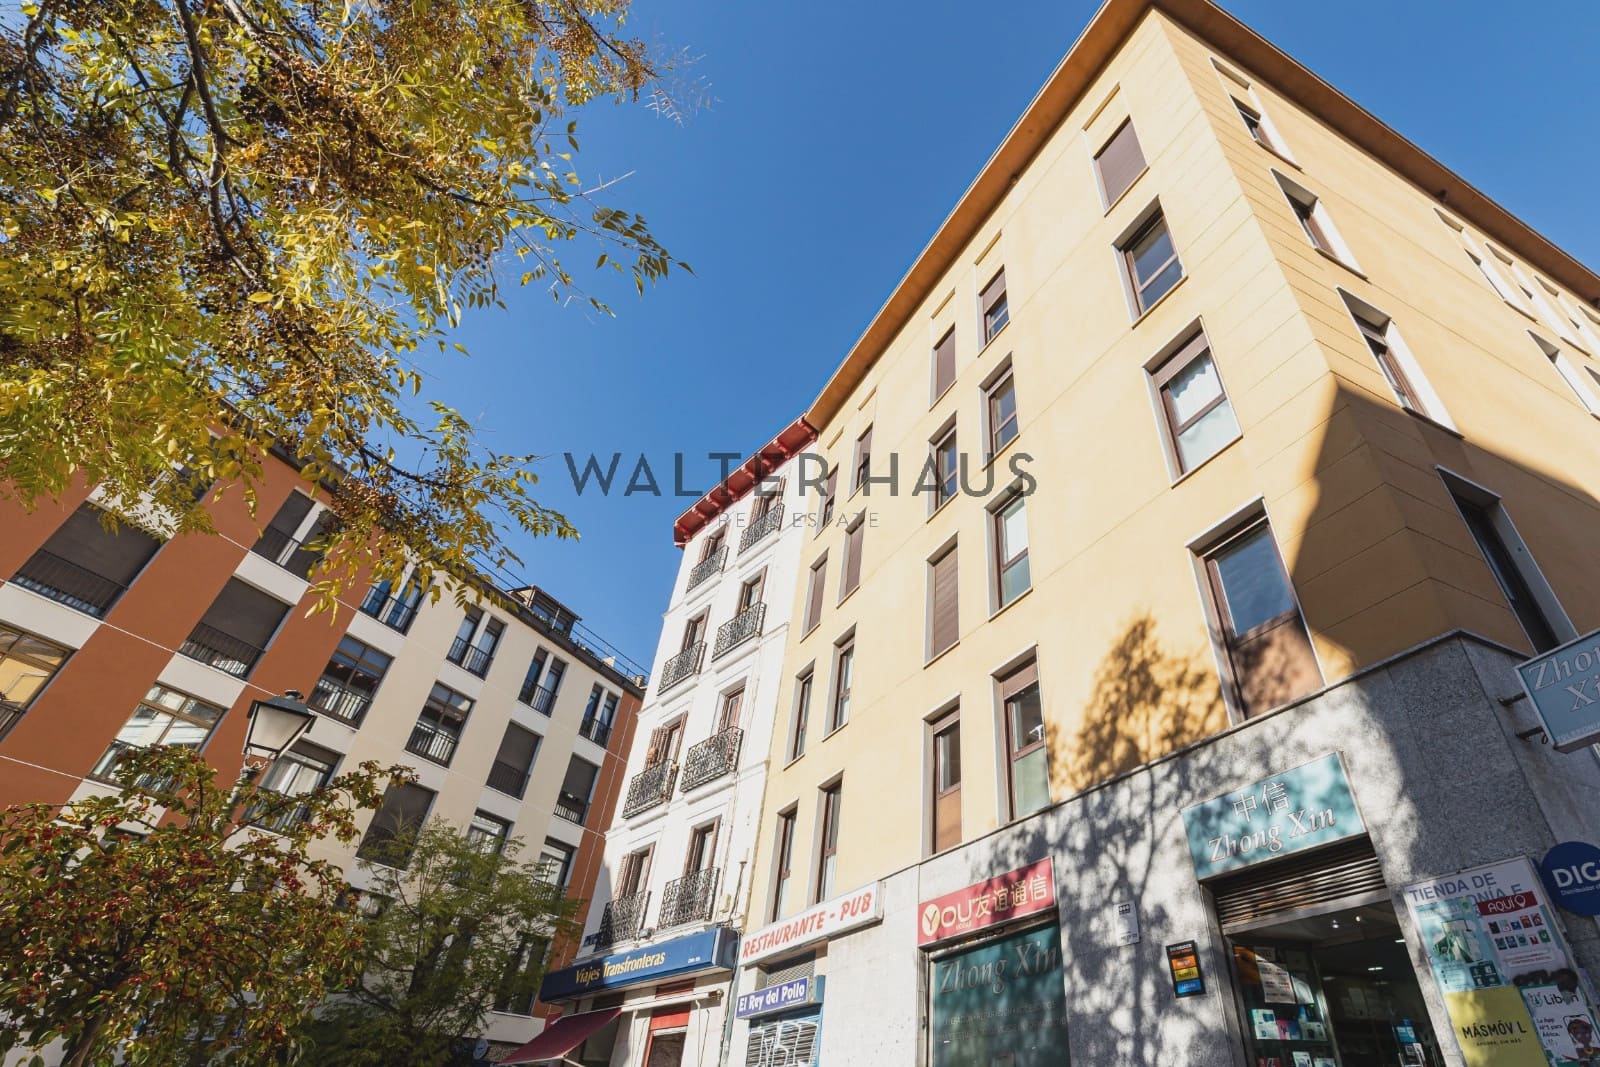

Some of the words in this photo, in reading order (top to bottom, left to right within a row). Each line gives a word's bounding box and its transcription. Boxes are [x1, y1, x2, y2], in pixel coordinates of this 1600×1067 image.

[1232, 781, 1290, 823] 中信
[1207, 823, 1284, 863] Zhong
[1287, 806, 1336, 839] Xin
[922, 898, 973, 935] YOU
[974, 874, 1048, 919] 友谊通信
[1409, 878, 1469, 902] TIENDA
[1471, 872, 1497, 889] DE
[742, 912, 826, 959] RESTAURANTE
[839, 891, 873, 923] PUB
[575, 967, 601, 986] Viajes
[602, 951, 666, 978] Transfronteras
[940, 957, 1008, 995] Zhong
[1014, 940, 1060, 980] Xin
[738, 996, 748, 1012] El
[749, 994, 764, 1011] Rey
[765, 989, 779, 1005] del
[781, 982, 805, 1002] Pollo
[1544, 993, 1580, 1006] Libn
